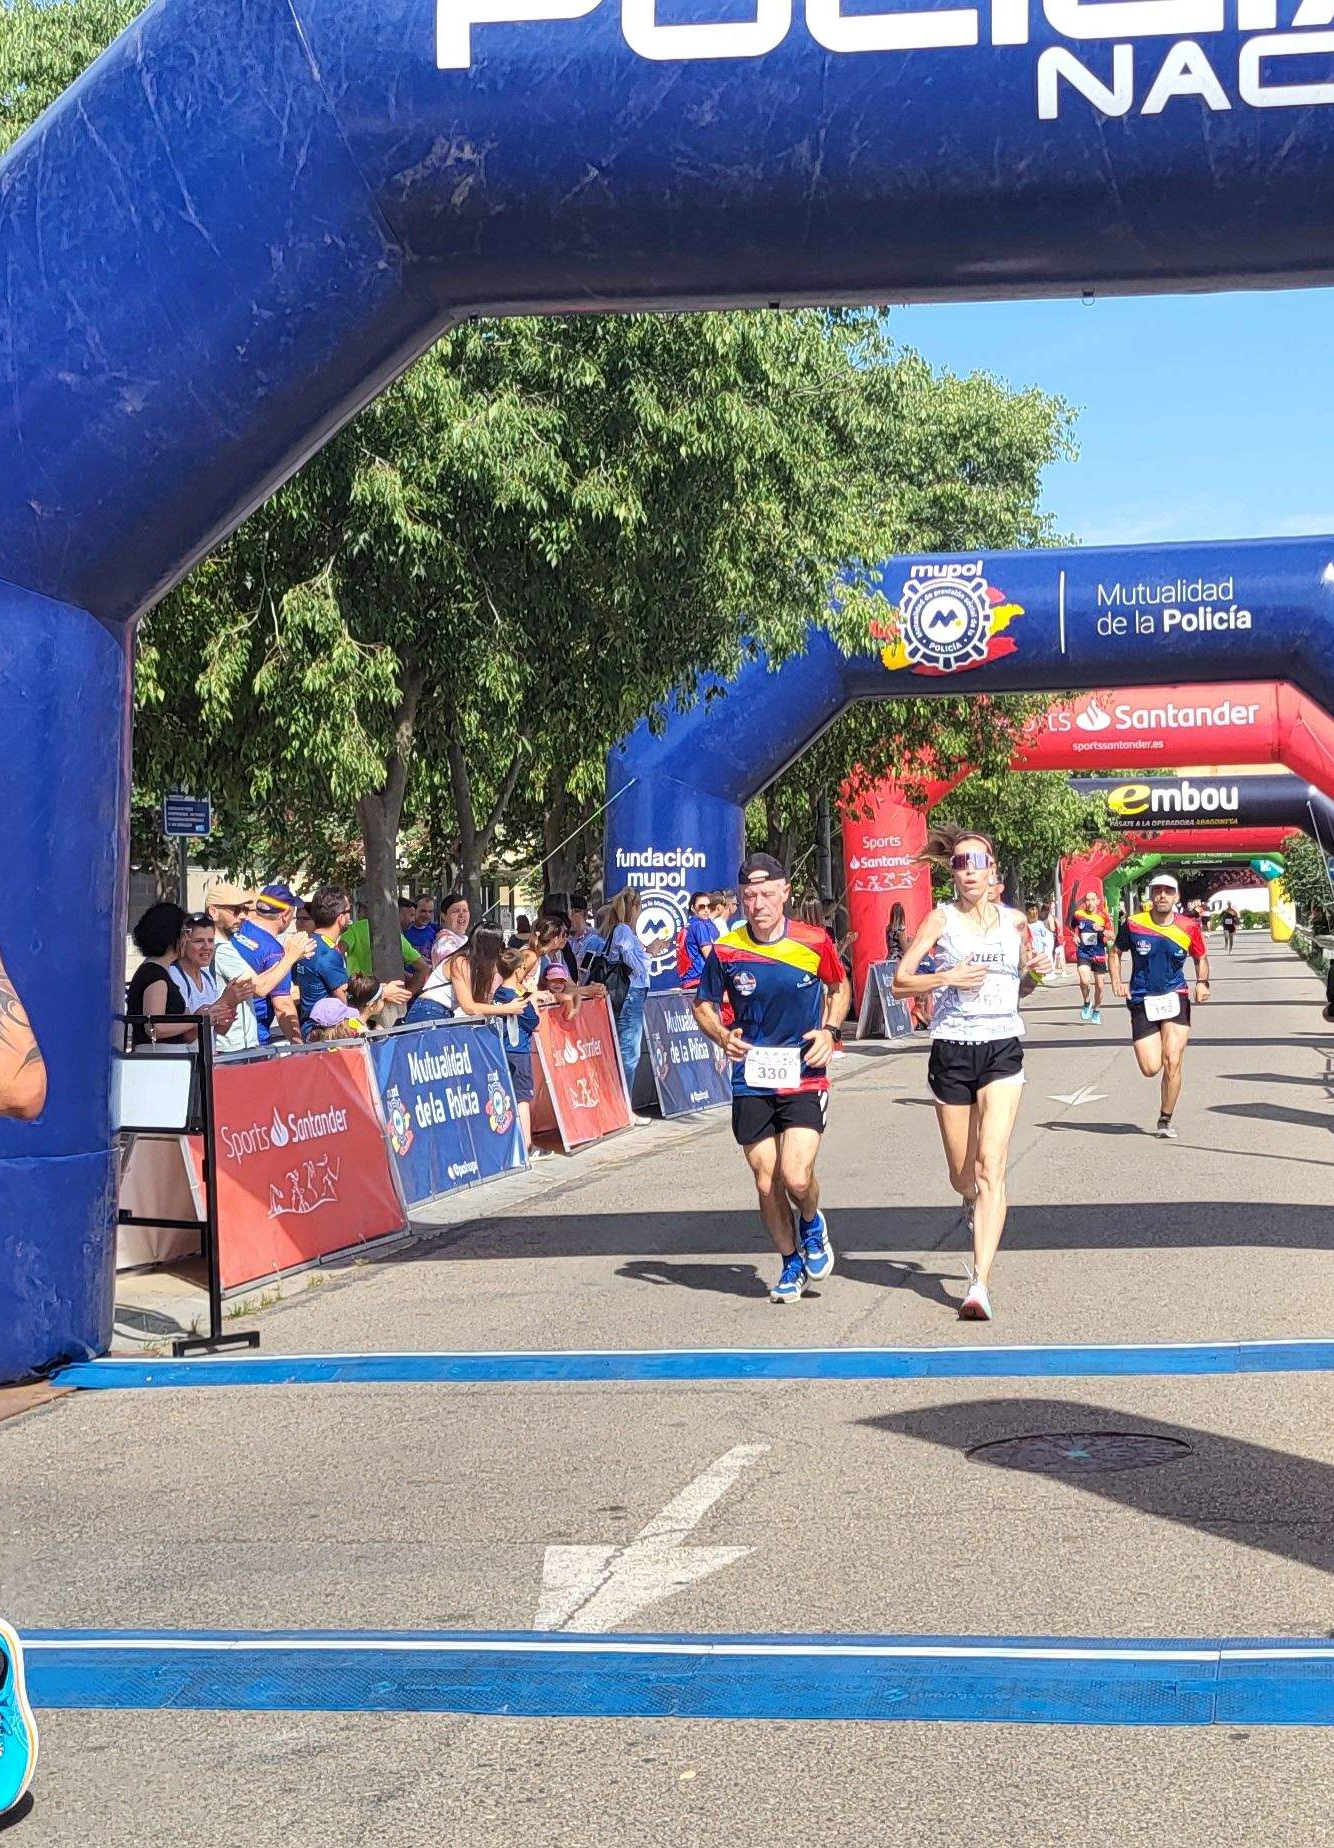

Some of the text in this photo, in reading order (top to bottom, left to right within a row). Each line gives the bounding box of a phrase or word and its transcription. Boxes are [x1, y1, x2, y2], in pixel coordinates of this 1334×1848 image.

[911, 560, 984, 578] mupol
[1097, 576, 1234, 606] Mutualidad
[1097, 605, 1252, 636] de la Policía
[1115, 700, 1260, 730] Santander
[1072, 739, 1164, 753] sportssantander.es
[1107, 780, 1239, 815] embou
[862, 835, 902, 849] Sports
[616, 847, 706, 868] fundación
[627, 868, 686, 888] mupol
[407, 1043, 473, 1086] Mutualidad
[670, 1041, 681, 1064] de
[680, 1039, 689, 1062] la
[757, 1066, 787, 1081] 330
[414, 1095, 432, 1129] de
[431, 1092, 446, 1124] la
[220, 1104, 348, 1165] Sports Santander
